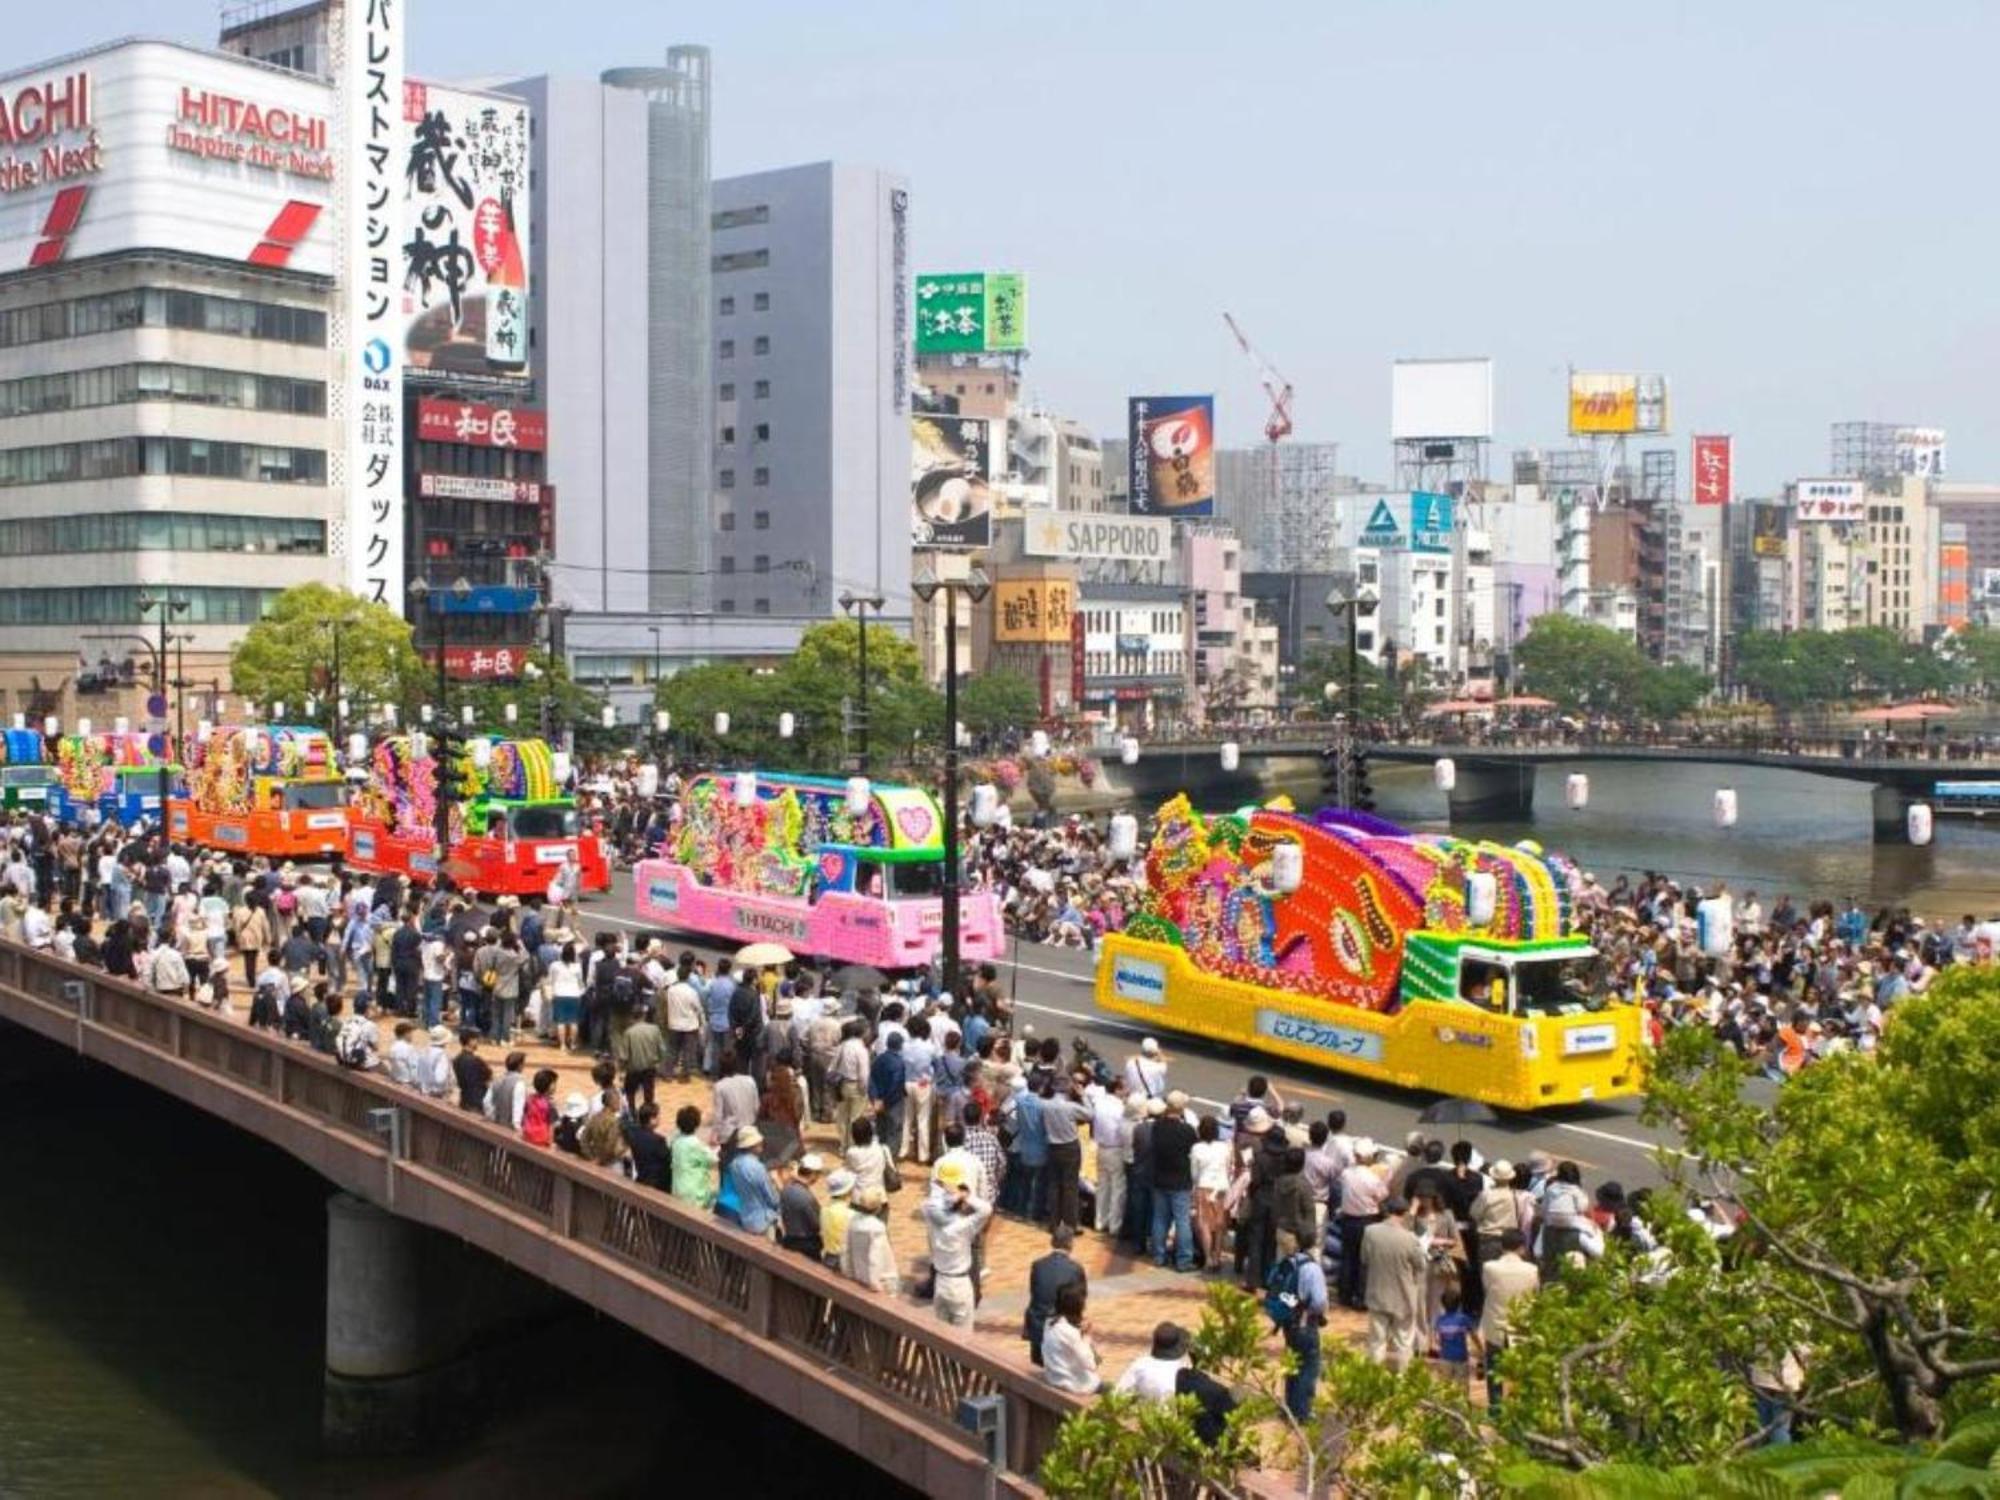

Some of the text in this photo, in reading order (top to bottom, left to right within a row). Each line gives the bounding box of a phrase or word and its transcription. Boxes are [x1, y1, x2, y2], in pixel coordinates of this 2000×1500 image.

[180, 86, 327, 151] HITACHI
[43, 128, 103, 178] Next
[169, 124, 336, 182] Inspire the Next
[364, 377, 391, 391] DAX
[455, 406, 519, 446] 和民
[366, 453, 391, 604] ダックス
[1067, 522, 1160, 556] SAPPORO
[469, 649, 513, 675] 和民
[745, 910, 795, 934] HITACHI
[1273, 1017, 1366, 1055] にしてつグループ
